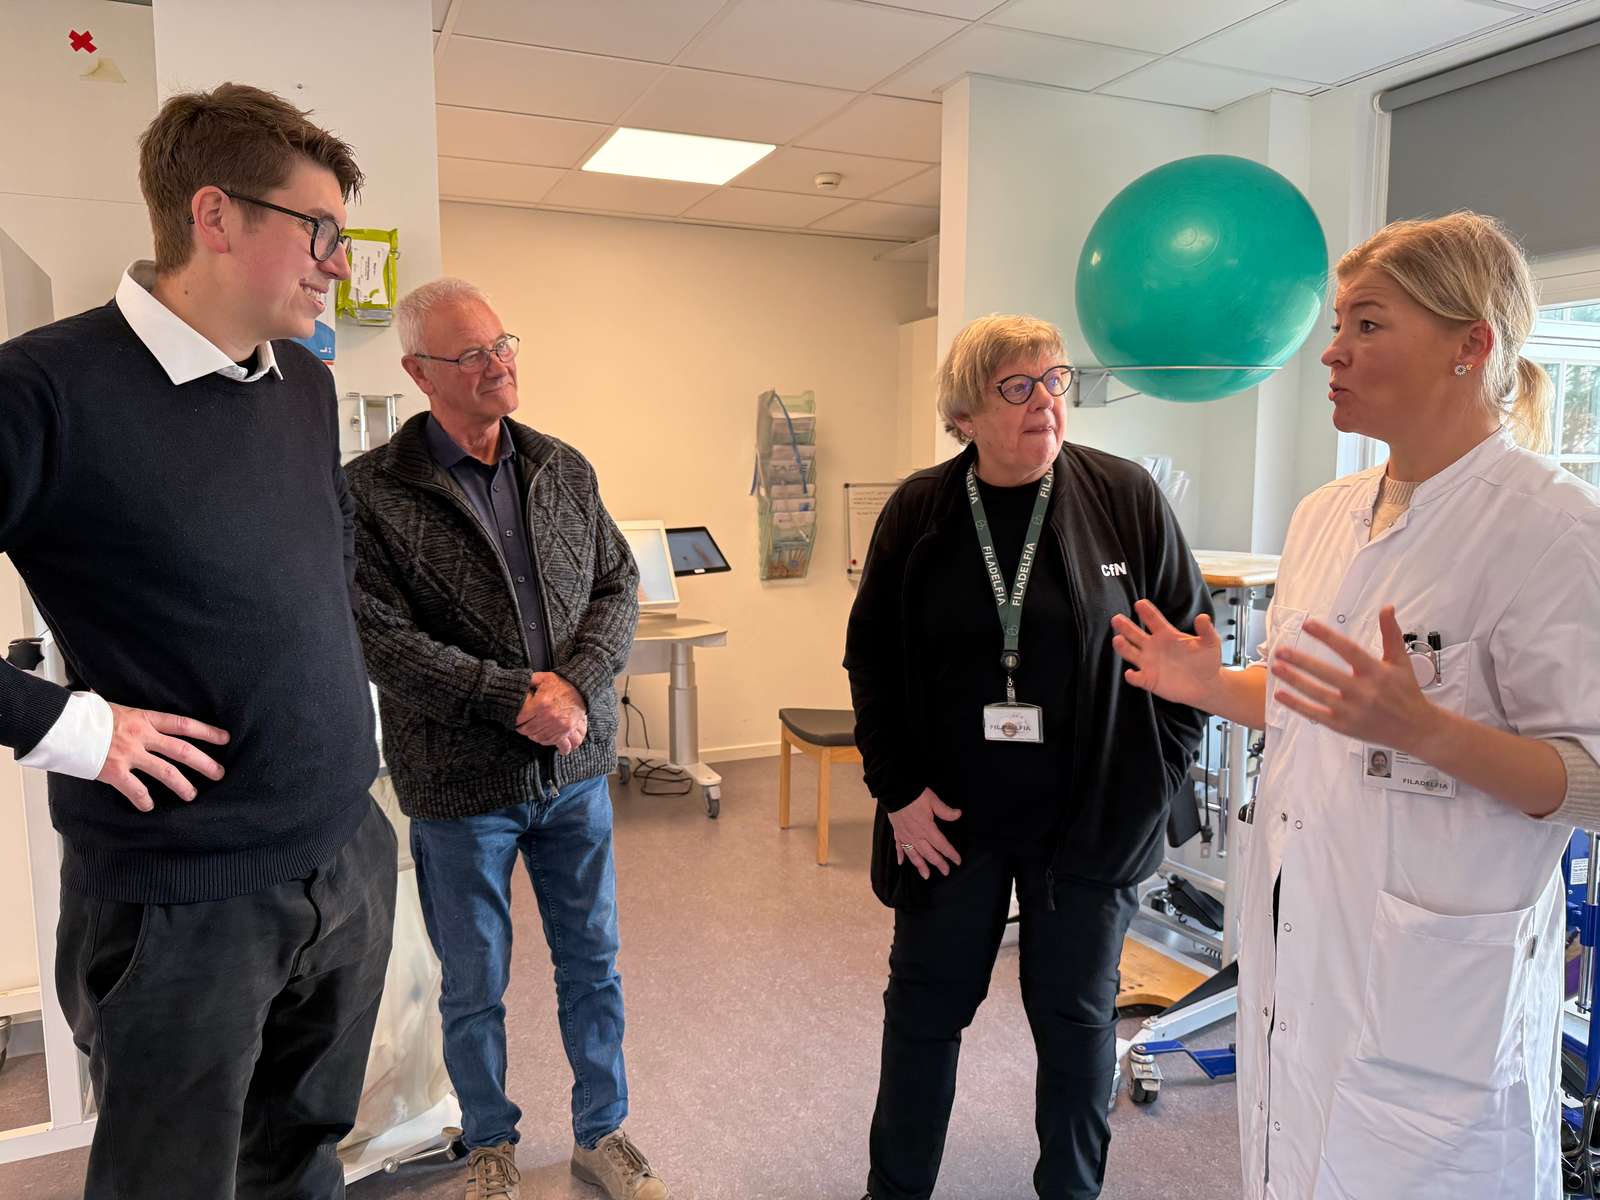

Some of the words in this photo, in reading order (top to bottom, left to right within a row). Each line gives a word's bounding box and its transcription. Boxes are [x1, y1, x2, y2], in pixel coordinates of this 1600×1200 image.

[983, 545, 1006, 606] FILADELFIA
[1012, 543, 1036, 606] FILADELFIA
[1100, 561, 1127, 577] CfN
[1402, 778, 1448, 790] FILADELFIA
